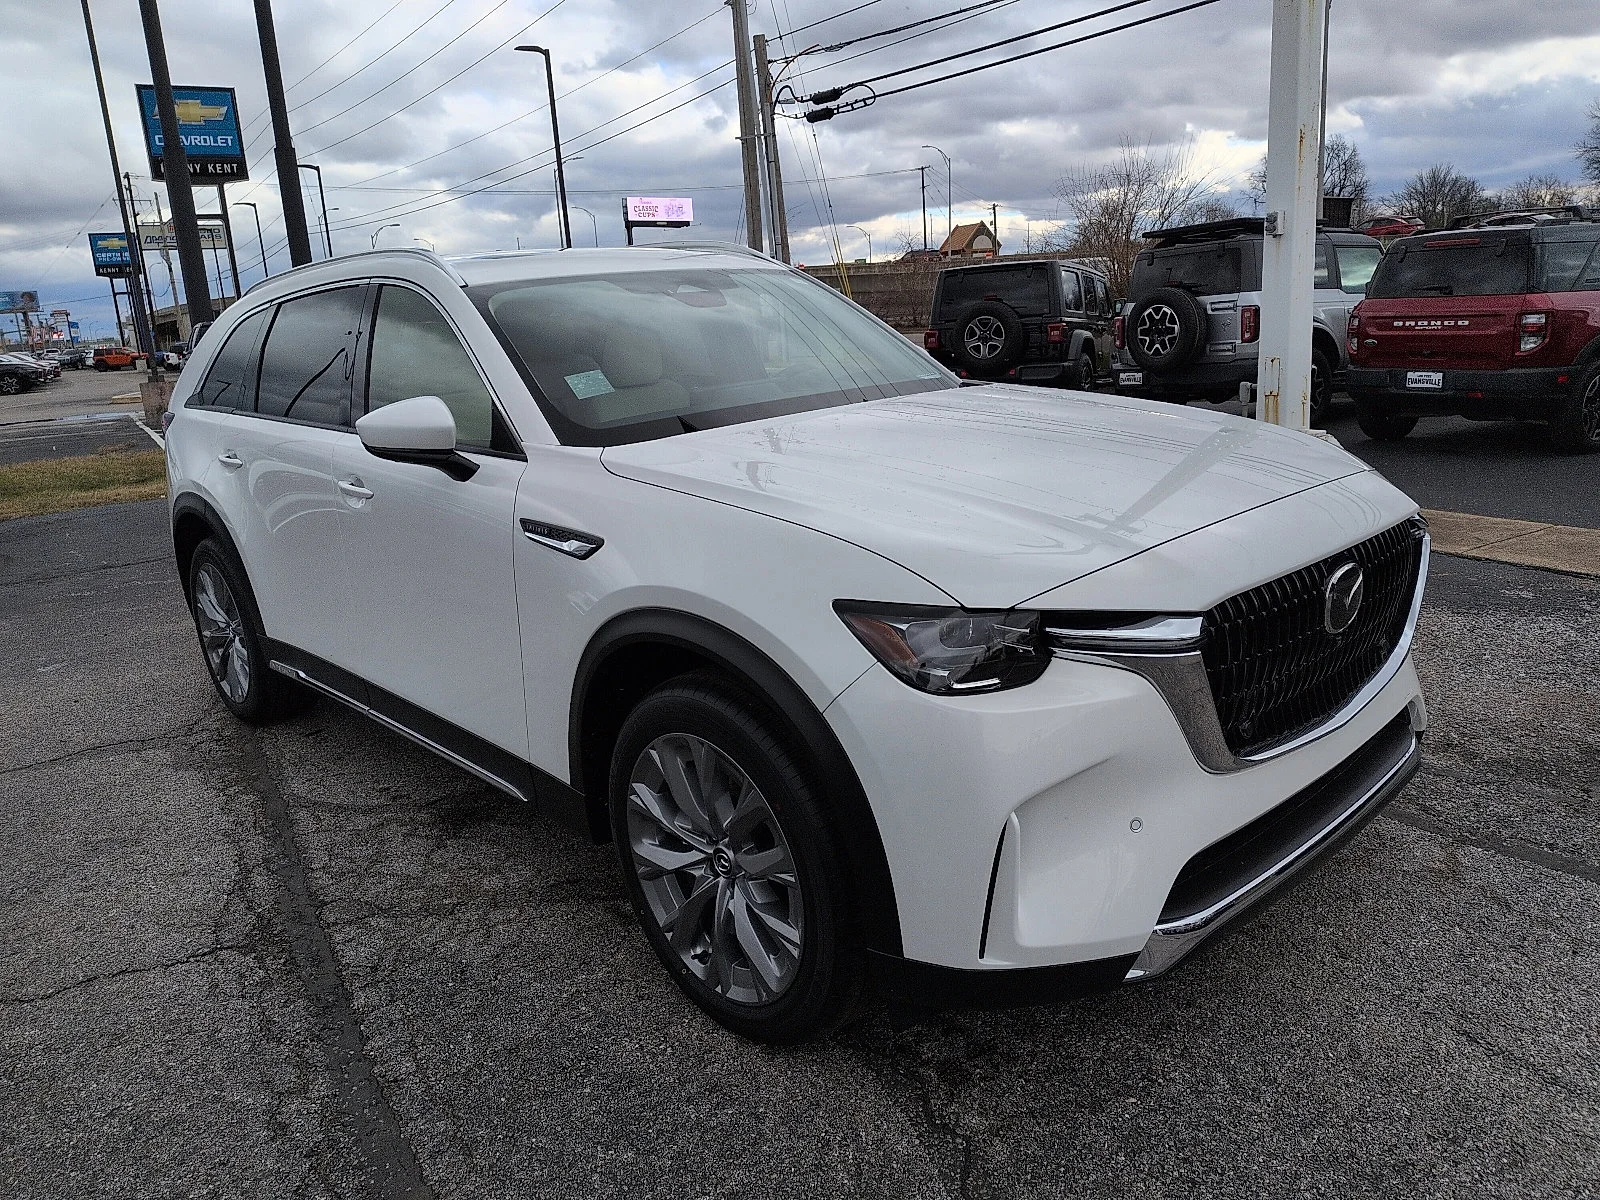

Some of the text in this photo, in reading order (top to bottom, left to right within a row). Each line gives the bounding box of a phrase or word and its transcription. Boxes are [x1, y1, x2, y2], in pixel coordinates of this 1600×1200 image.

[155, 135, 233, 146] CVROLET
[207, 163, 238, 174] KENT
[1408, 378, 1441, 386] EVANSVILLE
